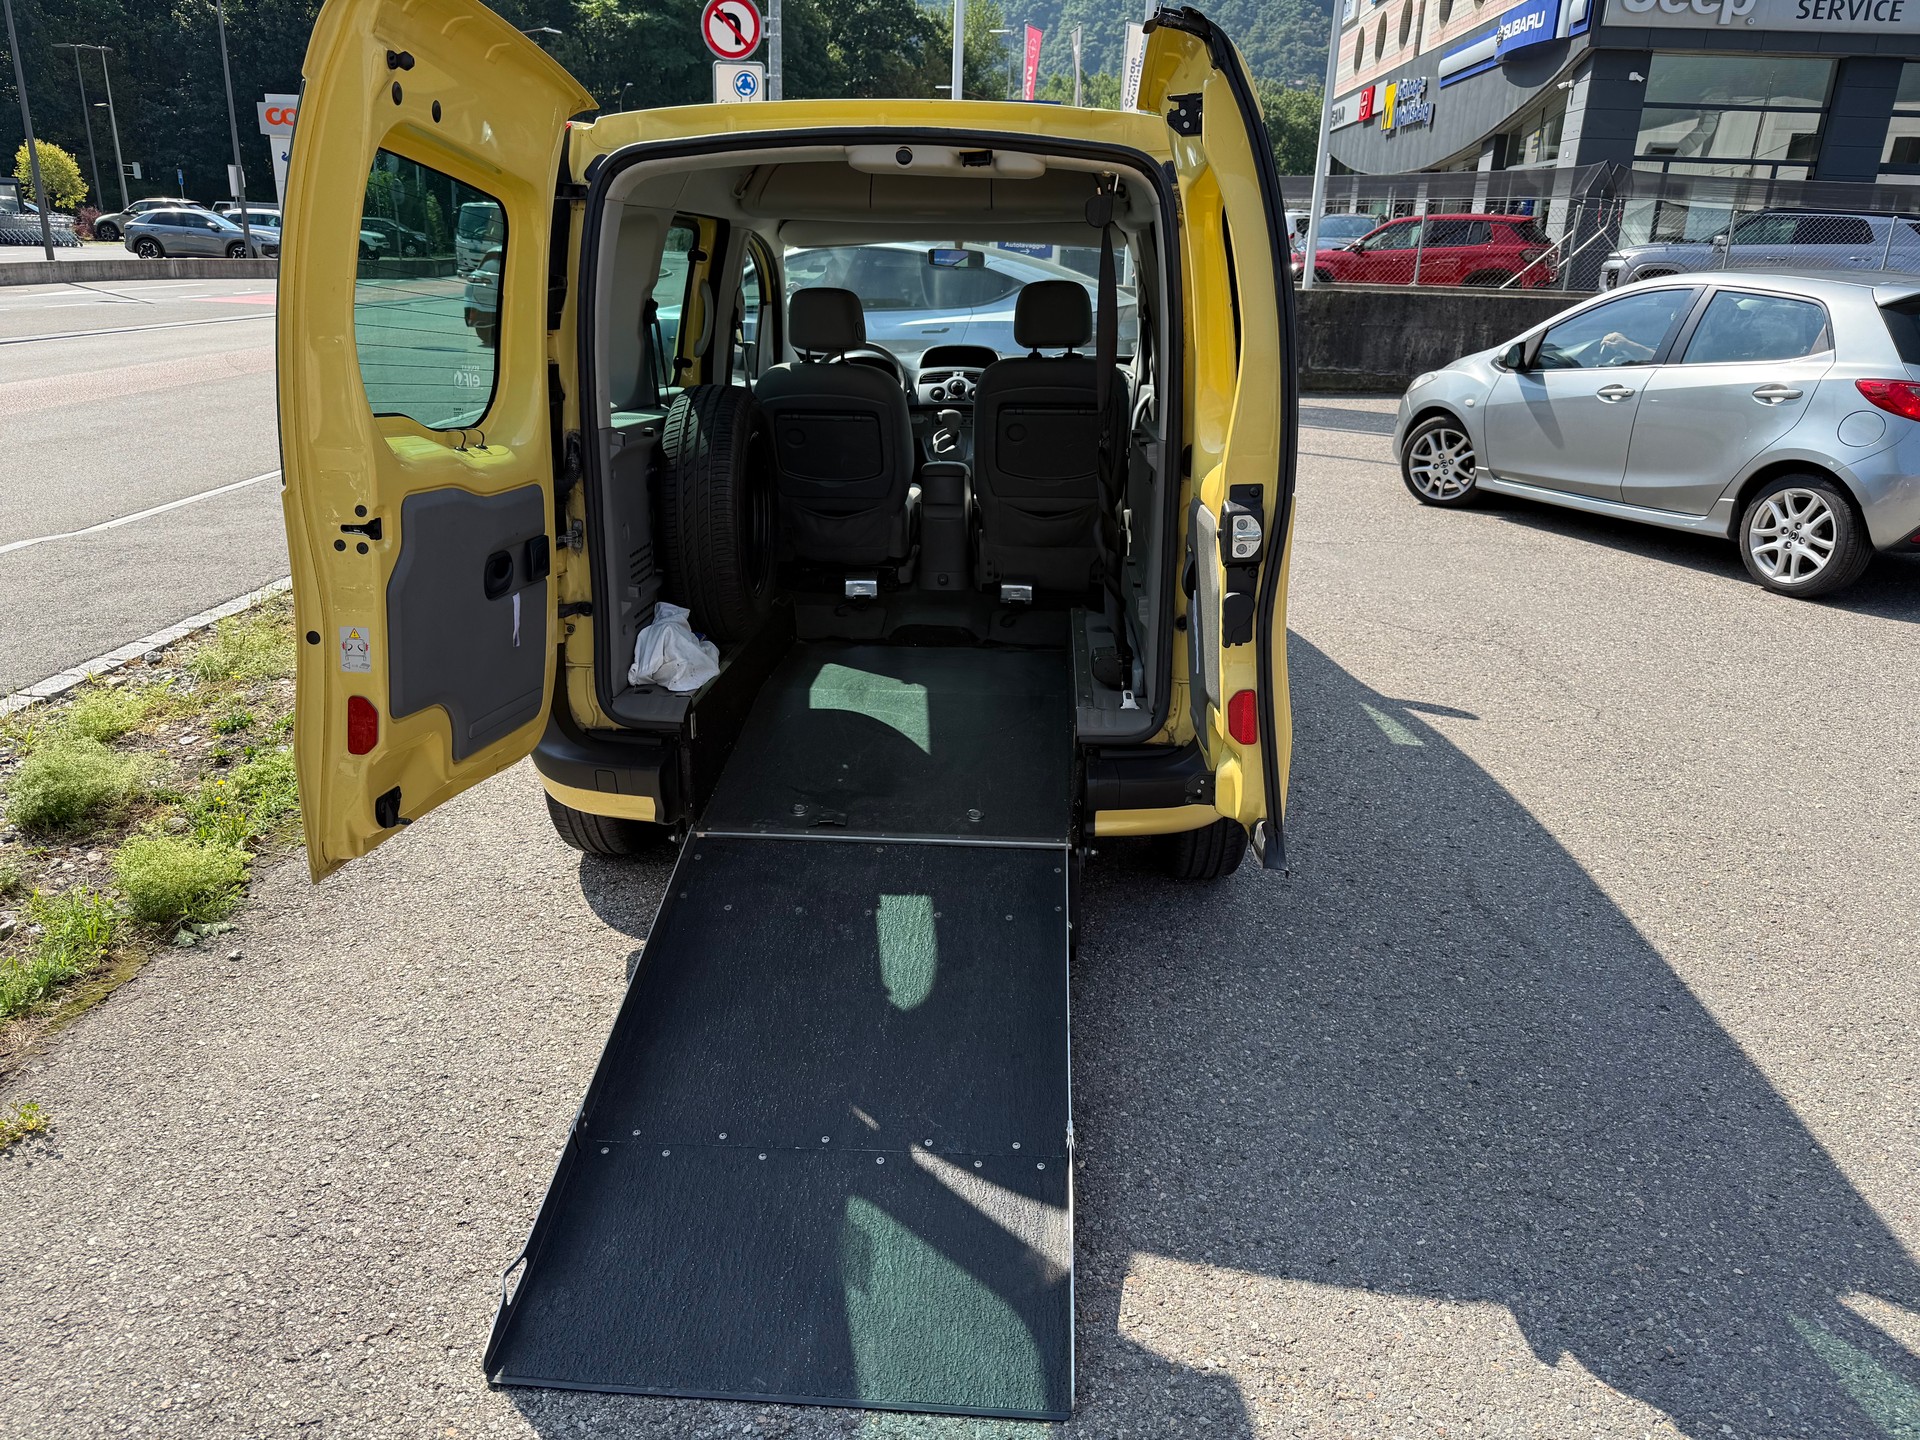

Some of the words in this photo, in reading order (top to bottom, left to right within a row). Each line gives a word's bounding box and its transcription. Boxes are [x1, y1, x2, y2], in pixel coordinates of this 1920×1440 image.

[1795, 0, 1904, 22] SERVICE
[1503, 10, 1546, 40] SUBARU
[1005, 242, 1046, 250] Autolavaggio
